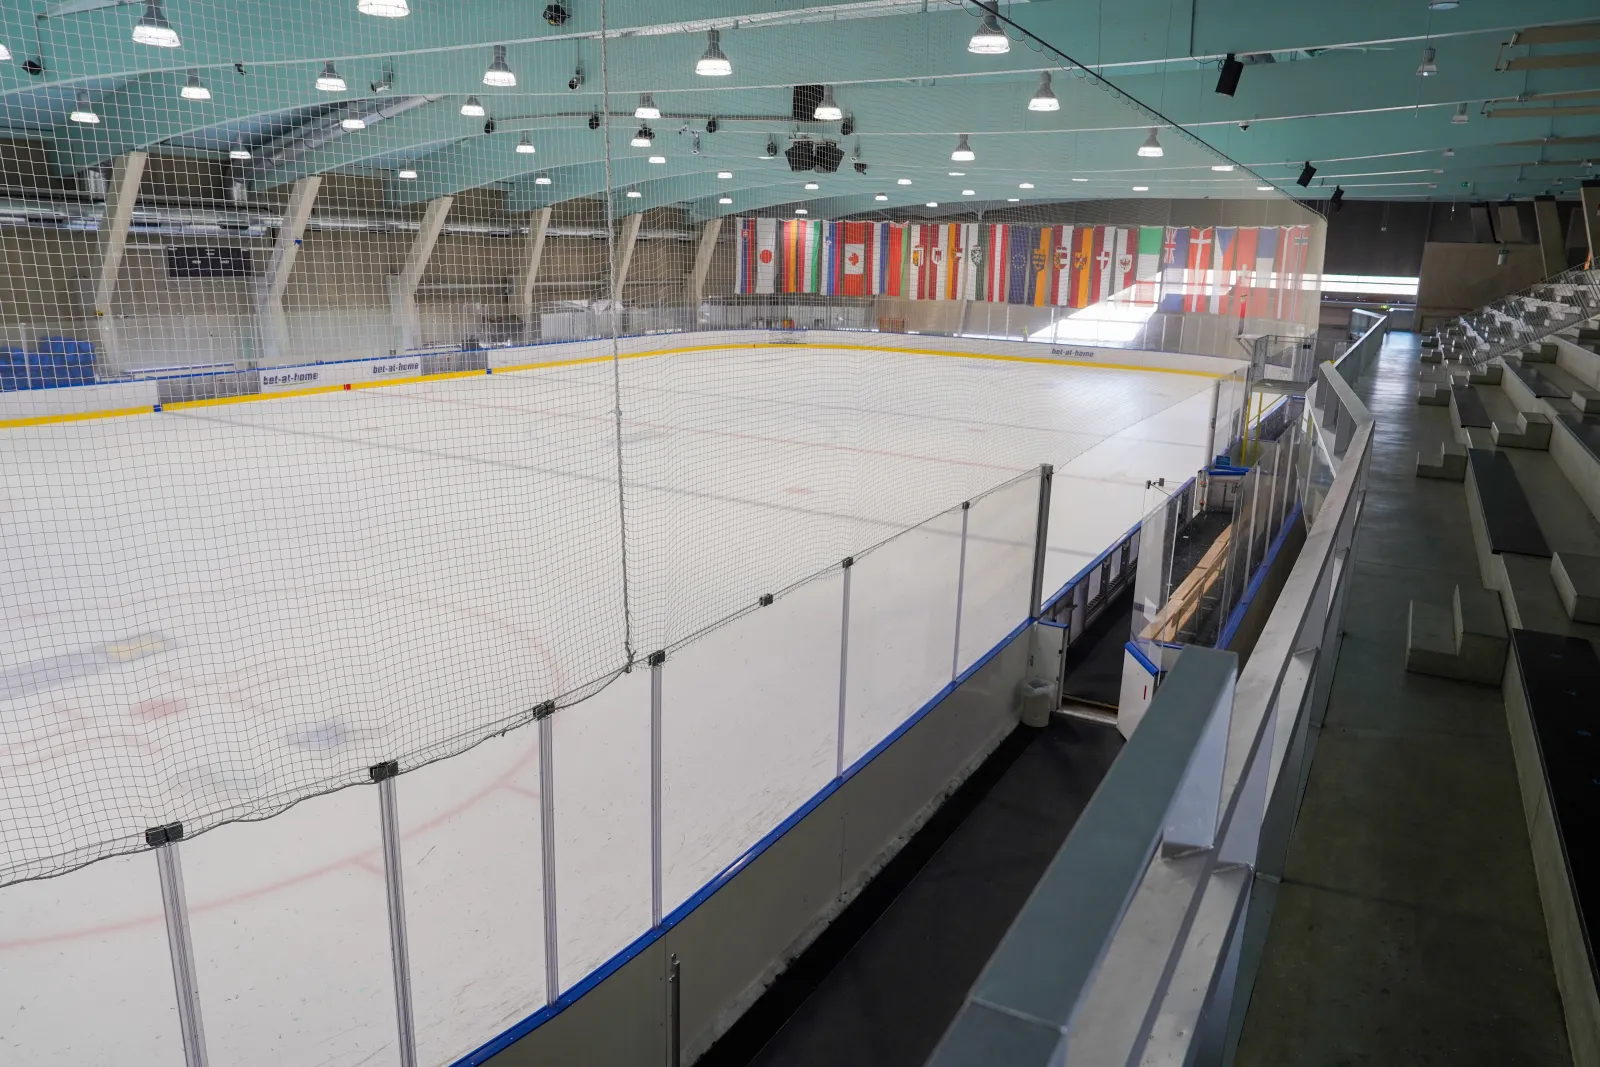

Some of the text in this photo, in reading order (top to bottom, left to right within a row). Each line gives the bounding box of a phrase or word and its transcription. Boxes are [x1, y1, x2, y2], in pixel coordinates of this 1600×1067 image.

[1051, 348, 1095, 357] bet-at-home
[372, 362, 419, 374] bet-at-home
[263, 372, 318, 385] bet-at-home
